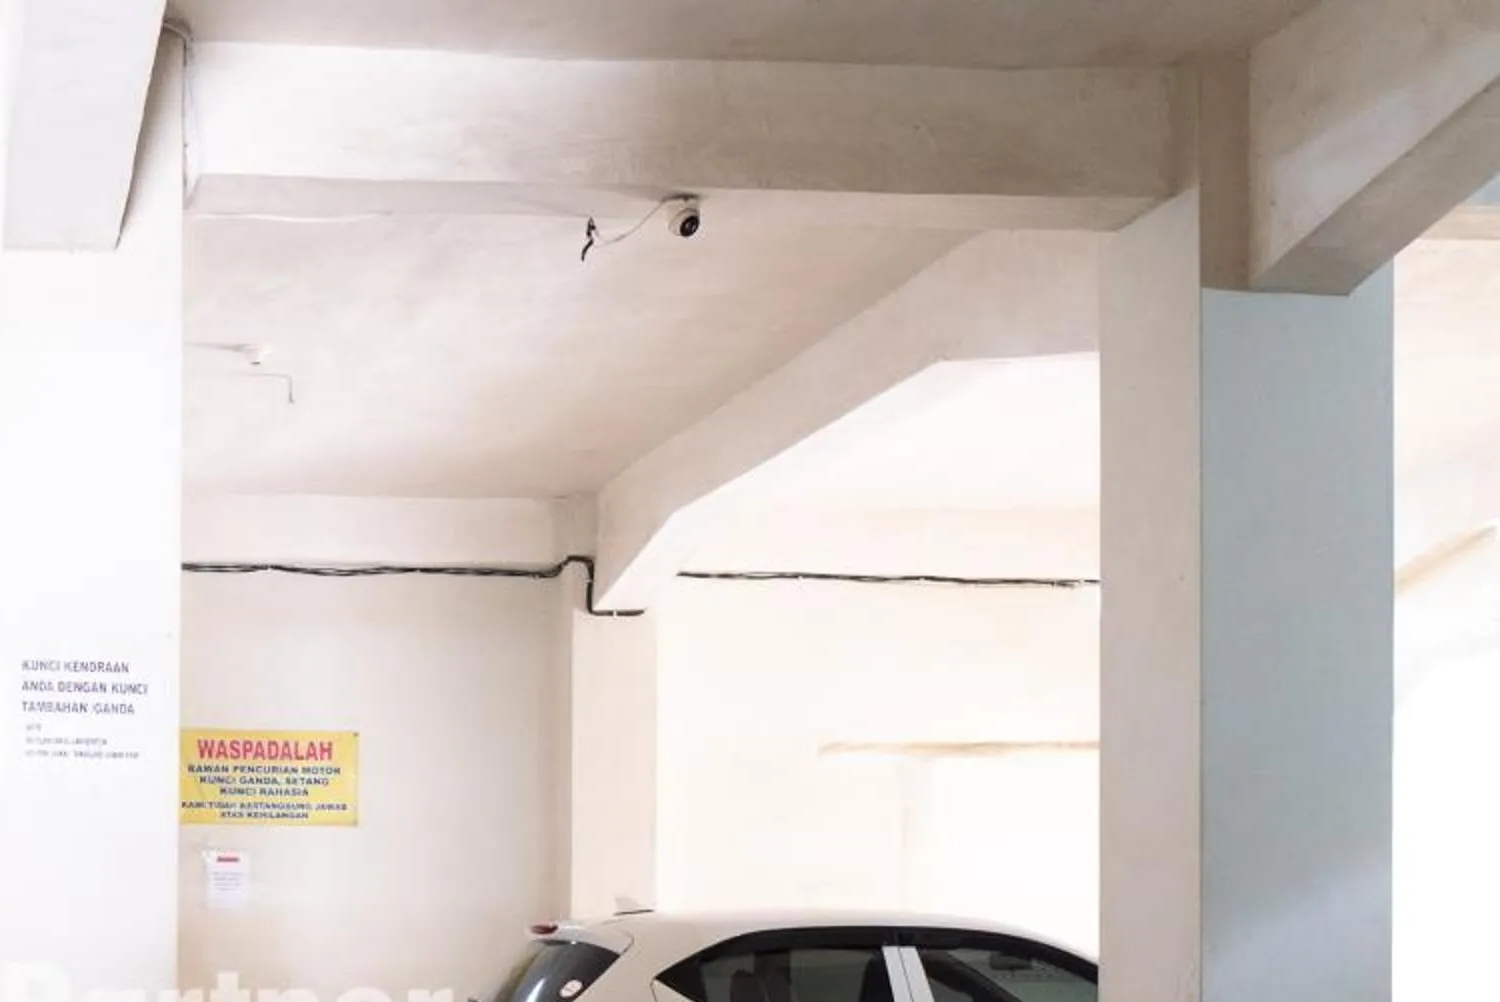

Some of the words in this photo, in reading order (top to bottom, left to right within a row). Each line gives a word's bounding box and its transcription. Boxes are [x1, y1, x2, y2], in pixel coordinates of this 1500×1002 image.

[21, 660, 60, 671] KUNCI
[21, 681, 54, 692] ANDA
[57, 682, 107, 693] DENGAN
[111, 684, 148, 695] KUNCI
[197, 739, 333, 762] WASPADALAH
[187, 764, 229, 773] RAWAN
[233, 765, 298, 774] PENCURIAN
